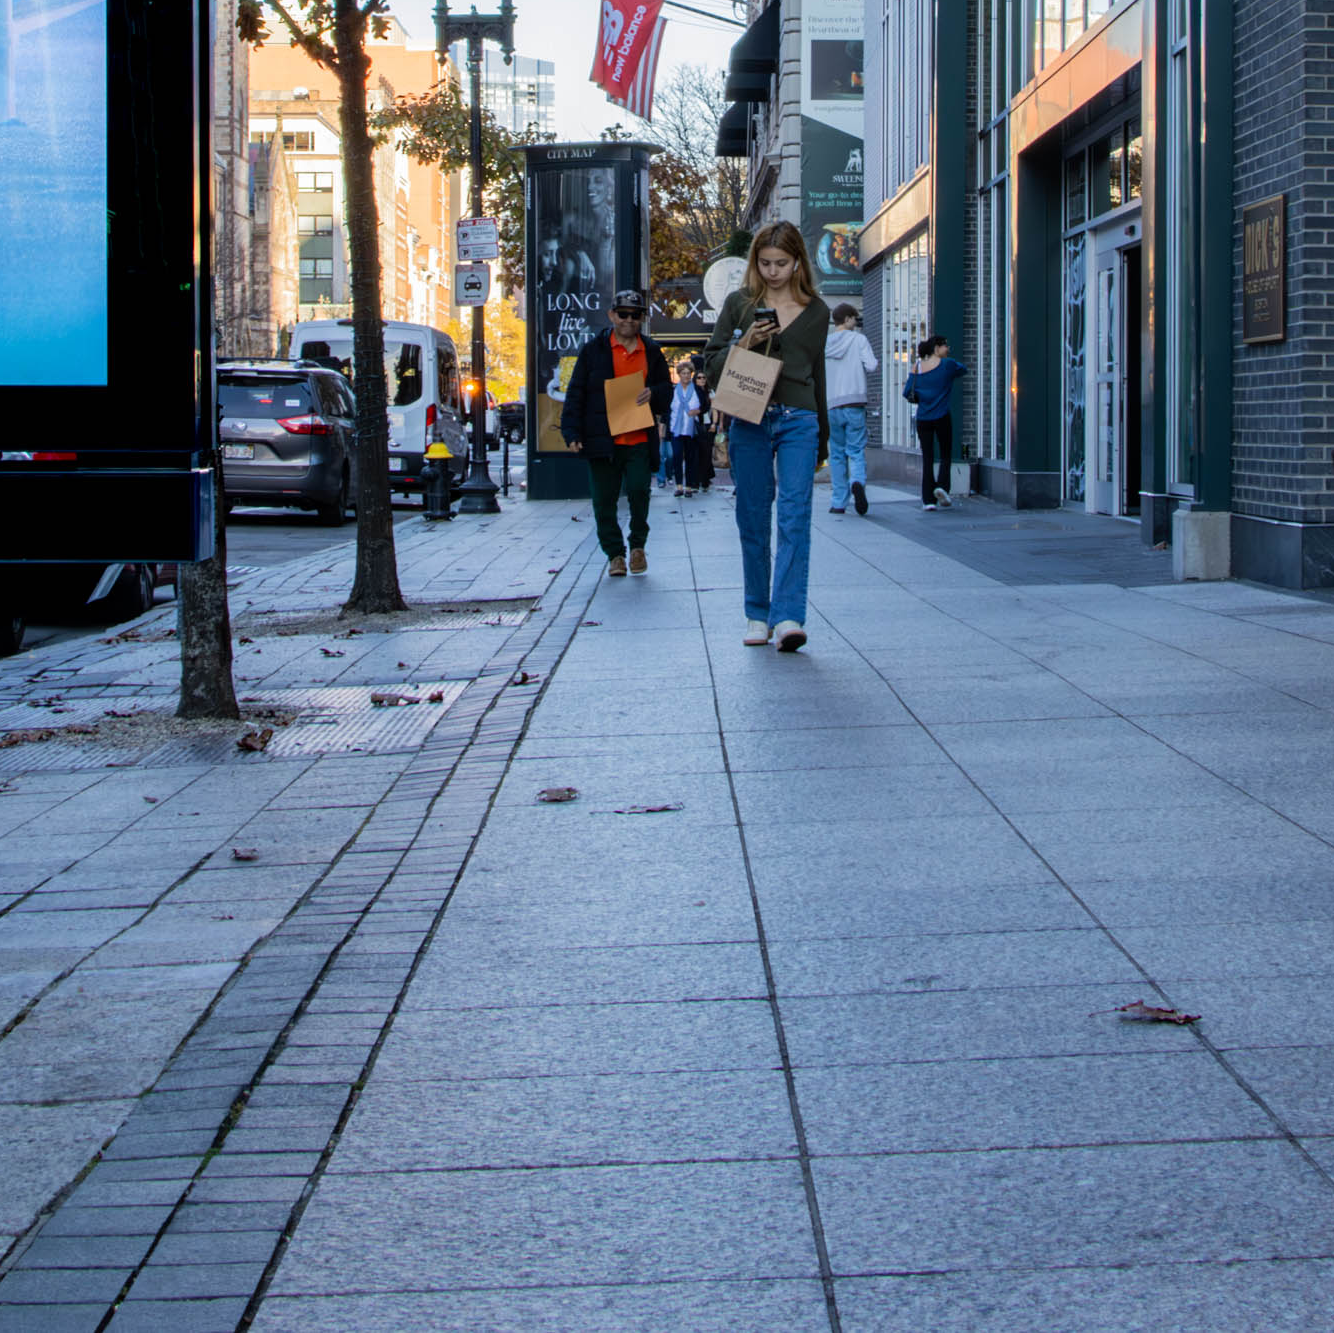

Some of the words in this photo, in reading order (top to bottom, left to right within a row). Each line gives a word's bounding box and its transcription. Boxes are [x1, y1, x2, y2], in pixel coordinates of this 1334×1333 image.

[618, 4, 648, 56] balance
[611, 55, 626, 83] new
[547, 149, 568, 160] CITY
[570, 148, 596, 158] MAP
[808, 191, 827, 200] Your
[828, 191, 848, 201] go-to
[815, 199, 835, 208] good
[836, 199, 853, 207] time
[547, 292, 601, 311] LONG
[559, 312, 587, 332] live
[727, 369, 768, 388] Marathon
[737, 380, 765, 396] Sports
